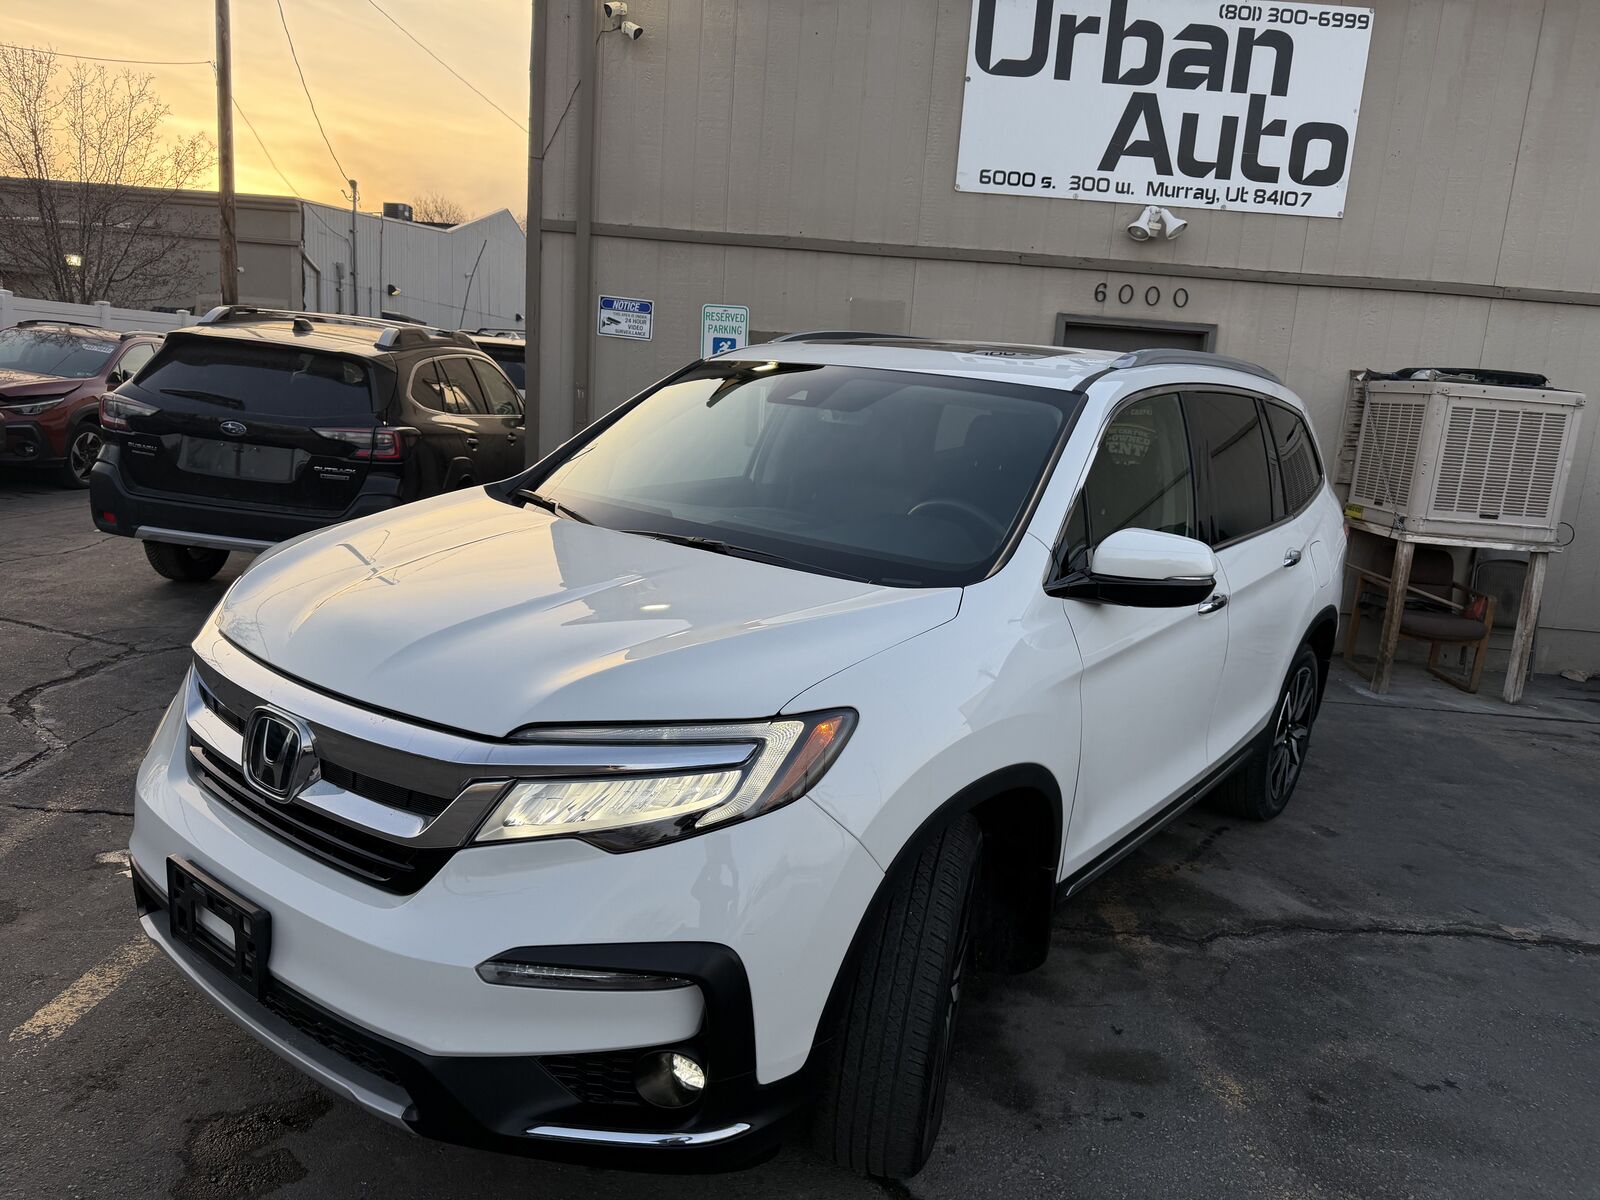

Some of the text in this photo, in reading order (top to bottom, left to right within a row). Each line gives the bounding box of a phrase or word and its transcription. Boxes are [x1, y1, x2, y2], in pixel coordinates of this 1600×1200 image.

[1219, 4, 1370, 30] (801) 300-6999
[974, 0, 1295, 97] Urban
[1097, 92, 1349, 187] Auto
[979, 169, 1036, 188] 6000
[1069, 175, 1111, 193] 300
[1146, 181, 1221, 205] Murray,
[1225, 186, 1249, 203] Ut
[1253, 188, 1312, 208] 84107
[612, 300, 641, 312] NOTICE
[1094, 282, 1189, 308] 6000
[705, 311, 746, 323] RESERVED
[707, 324, 743, 335] PARKING
